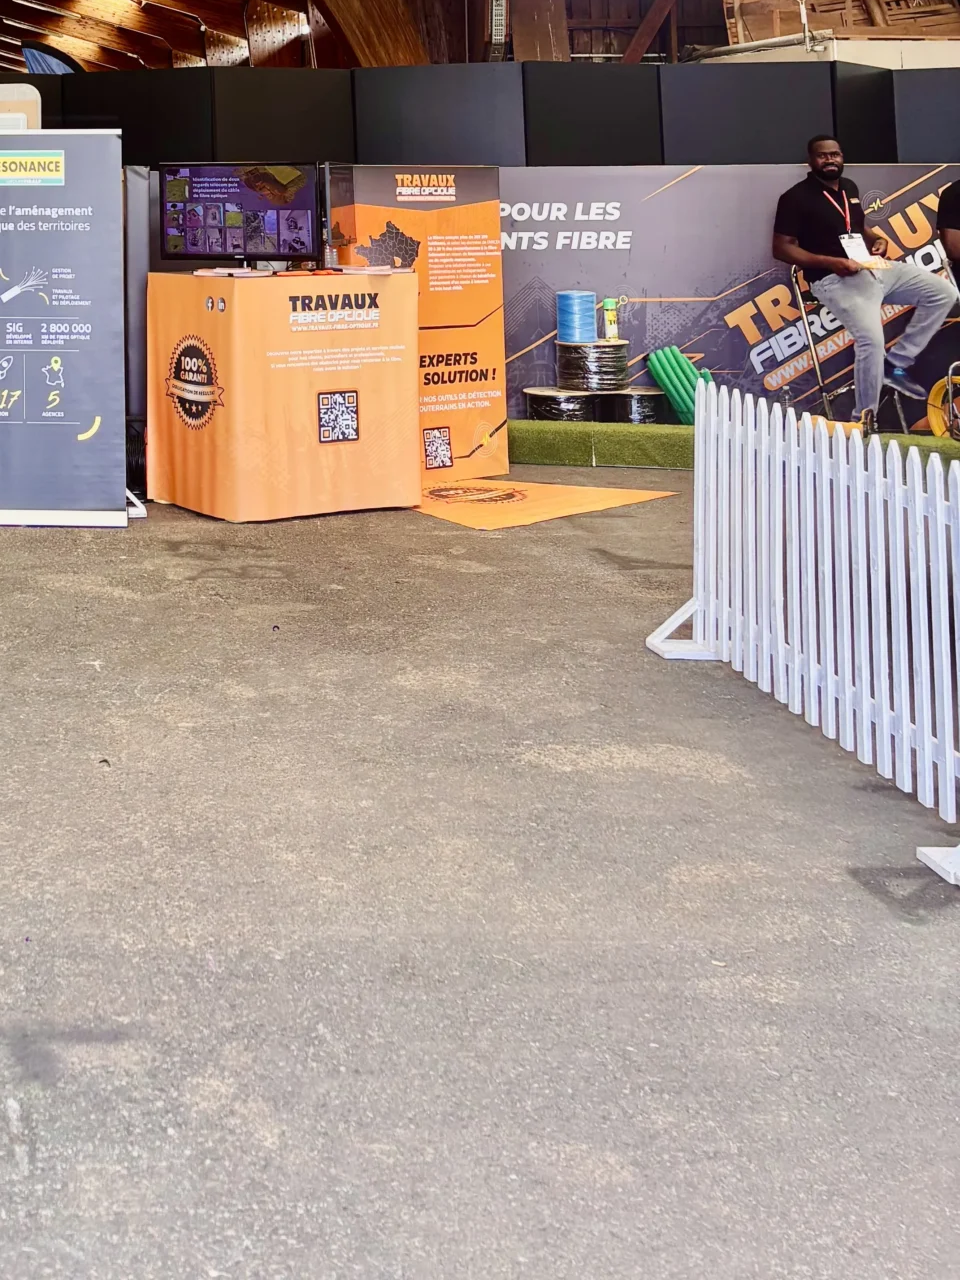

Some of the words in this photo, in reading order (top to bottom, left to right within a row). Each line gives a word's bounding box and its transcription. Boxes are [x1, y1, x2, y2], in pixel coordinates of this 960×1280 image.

[395, 174, 455, 187] TRAVAUX
[396, 187, 420, 195] FIBRE
[421, 187, 456, 195] OPTIQUE
[8, 205, 93, 218] l'aménagement
[500, 202, 568, 221] POUR
[574, 202, 621, 221] LES
[17, 220, 36, 231] des
[38, 221, 91, 231] territoires
[556, 231, 633, 250] FIBRE
[289, 293, 379, 312] TRAVAUX
[289, 311, 327, 324] FIBRE
[327, 310, 380, 322] OPTIQUE
[6, 323, 23, 332] SIG
[41, 323, 47, 333] 2
[50, 323, 70, 333] 800
[71, 323, 92, 333] 000
[749, 305, 842, 375] FIBRE
[181, 357, 207, 373] 100%
[419, 352, 478, 368] EXPERTS
[180, 371, 207, 383] GARANTI
[424, 368, 489, 386] SOLUTION
[492, 368, 496, 381] !
[46, 390, 60, 409] 5
[423, 395, 436, 403] NOS
[459, 392, 467, 400] DE
[468, 390, 502, 398] DÉTECTION
[467, 400, 491, 408] ACTION.
